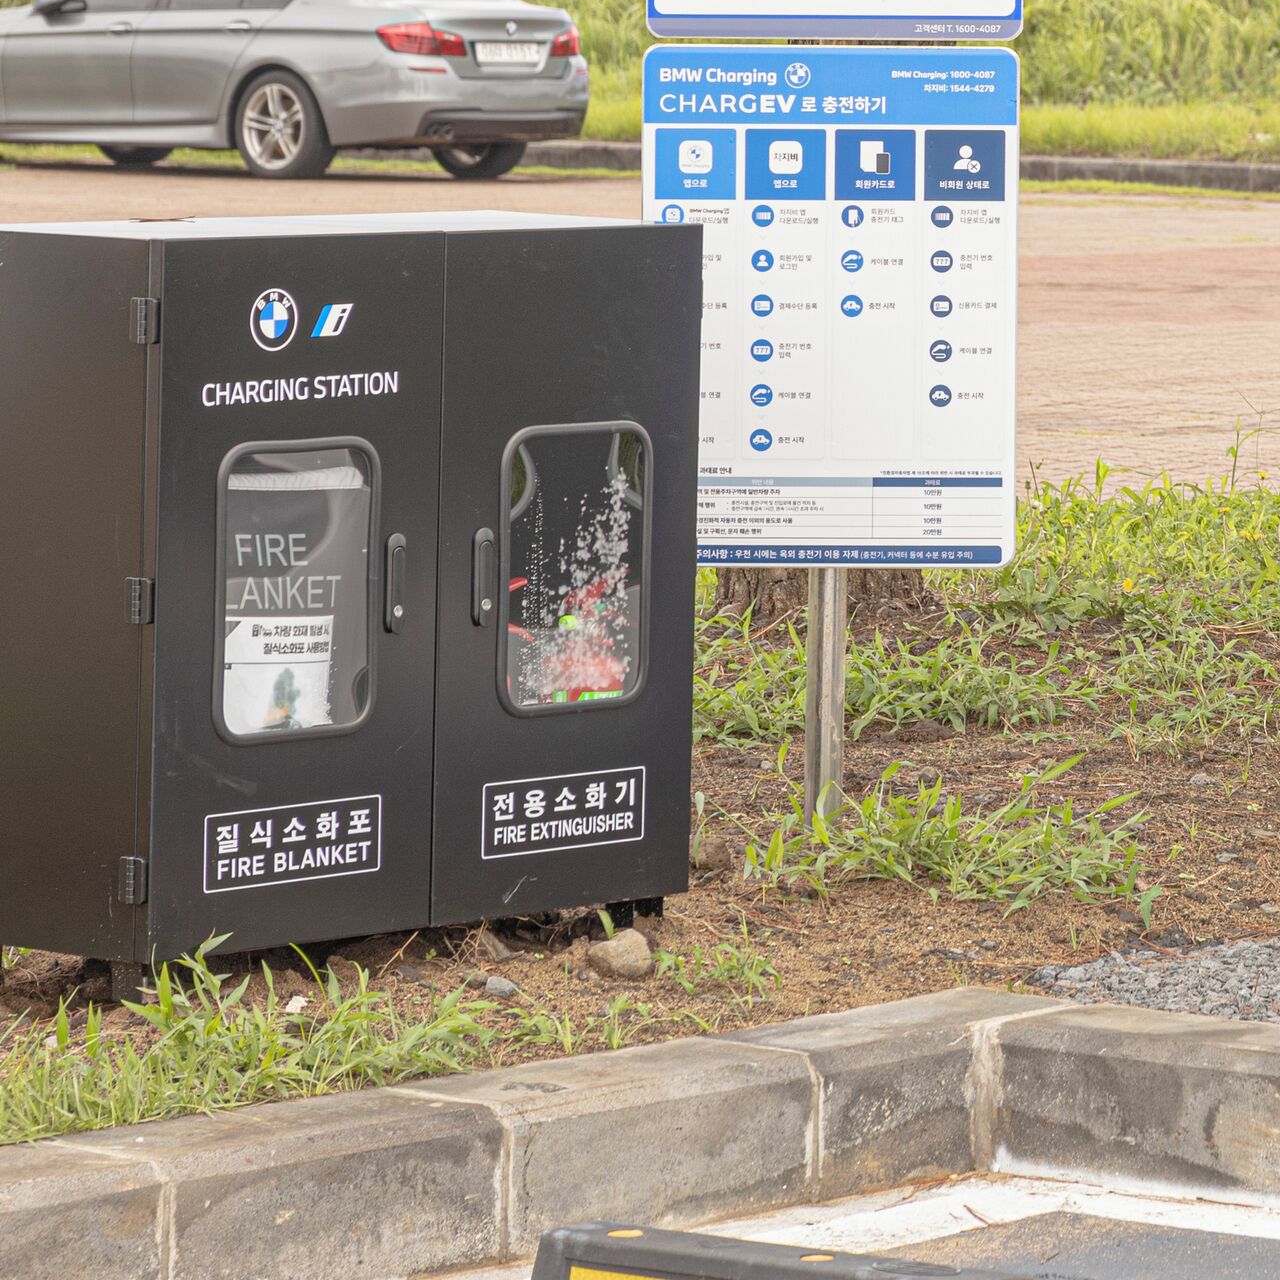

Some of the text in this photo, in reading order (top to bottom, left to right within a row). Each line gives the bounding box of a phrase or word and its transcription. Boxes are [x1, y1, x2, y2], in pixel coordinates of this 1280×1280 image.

[914, 24, 1001, 33] 고객센터 T. 1600-4087
[659, 67, 777, 85] BMW Charging
[892, 71, 995, 80] BMW Charging: 1600-4087
[923, 84, 995, 93] 차지비: 1544-4279
[659, 94, 887, 115] CHARGEV 로 충전하기
[773, 151, 799, 163] 차지비
[683, 178, 708, 189] 앱으로
[773, 178, 798, 189] 앱으로
[855, 179, 896, 189] 회원카드로
[939, 180, 991, 190] 비회원 상태로
[256, 292, 292, 311] BMW
[201, 370, 399, 407] CHARGING STATION
[778, 436, 805, 444] 충전 시작
[234, 533, 309, 567] FIRE
[734, 549, 751, 560] 우천
[753, 549, 777, 560] 시에는
[779, 549, 796, 560] 옥외
[797, 549, 822, 560] 충전기
[824, 549, 840, 560] 이용
[842, 549, 859, 560] 자제
[860, 549, 885, 560] (충전기,
[887, 549, 908, 560] 커넥터
[909, 549, 924, 560] 등에
[925, 549, 940, 560] 수분
[941, 549, 955, 560] 유입
[956, 549, 973, 560] 주의)
[263, 642, 305, 655] 질식소화포
[494, 811, 635, 846] FIRE EXTINGUISHER
[217, 840, 372, 881] FIRE BLANKET
